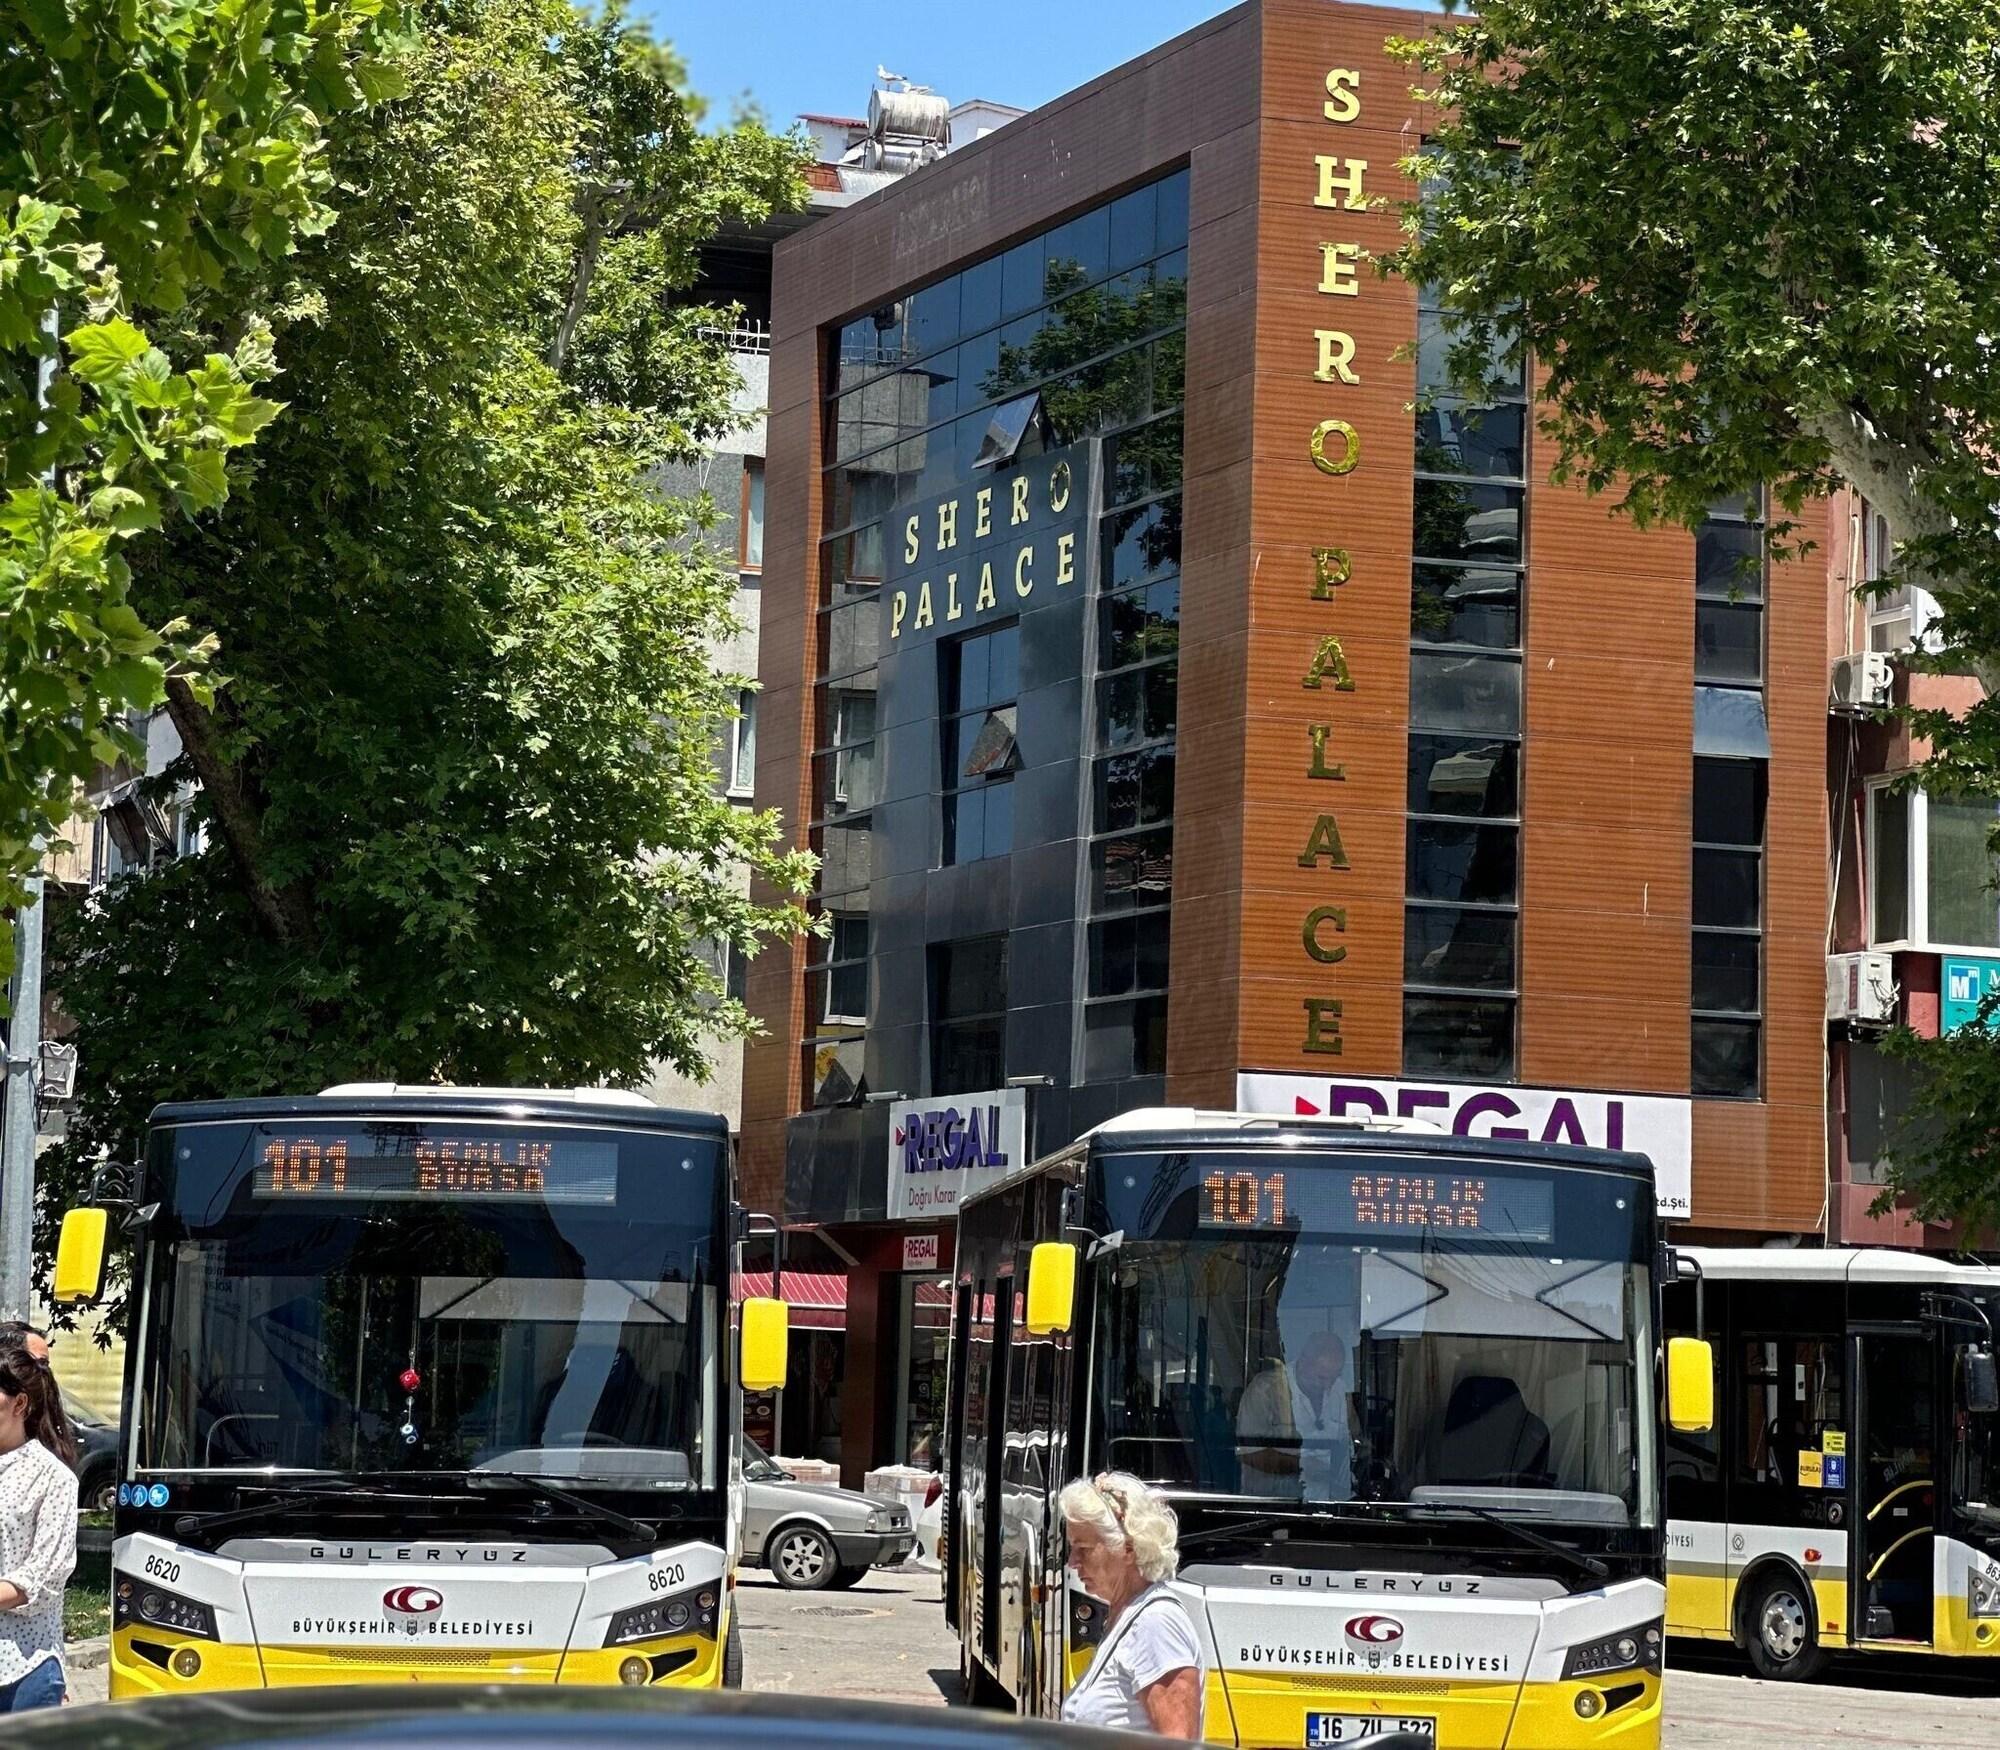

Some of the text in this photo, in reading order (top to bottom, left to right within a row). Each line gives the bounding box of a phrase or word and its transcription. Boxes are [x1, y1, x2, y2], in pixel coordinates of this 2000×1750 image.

[904, 461, 1072, 565] SHERO
[1298, 68, 1368, 1056] SHERO PALACE
[891, 532, 1075, 638] PALACE
[905, 1105, 1008, 1174] REGAL
[264, 1138, 348, 1191] 101
[1204, 1170, 1285, 1225] 101
[908, 1238, 936, 1258] REGAL
[145, 1554, 181, 1583] 8620
[309, 1546, 528, 1563] GÜLERYÜZ
[648, 1563, 686, 1592] 8620
[1269, 1573, 1480, 1594] GÜLERYÜZ
[292, 1617, 533, 1636] BÜYÜKŞEHİR BELEDİYESİ
[1240, 1644, 1509, 1672] BÜYÜKŞEHİR BELEDİYESİ
[1322, 1717, 1343, 1739] 16
